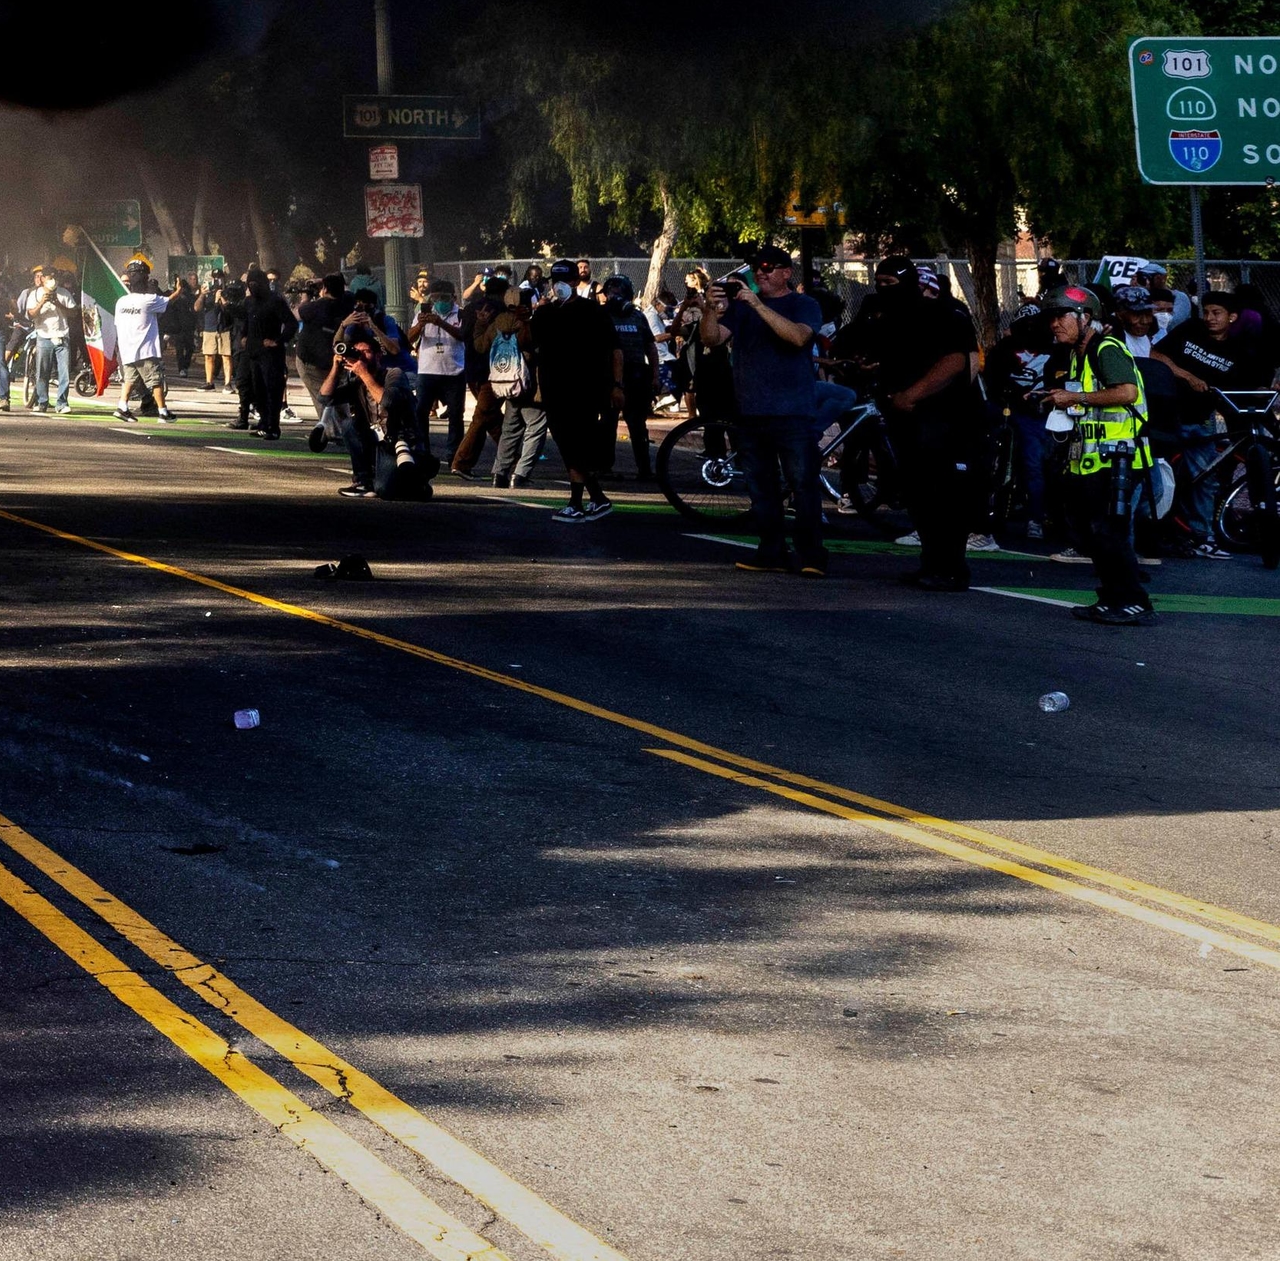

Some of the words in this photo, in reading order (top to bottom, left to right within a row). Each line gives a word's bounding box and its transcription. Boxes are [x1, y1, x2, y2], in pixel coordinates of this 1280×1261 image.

[1172, 57, 1202, 72] 101
[1179, 101, 1207, 115] 110
[358, 109, 378, 123] 101
[388, 109, 449, 124] NORTH
[1183, 146, 1209, 160] 110
[1184, 347, 1192, 355] OF
